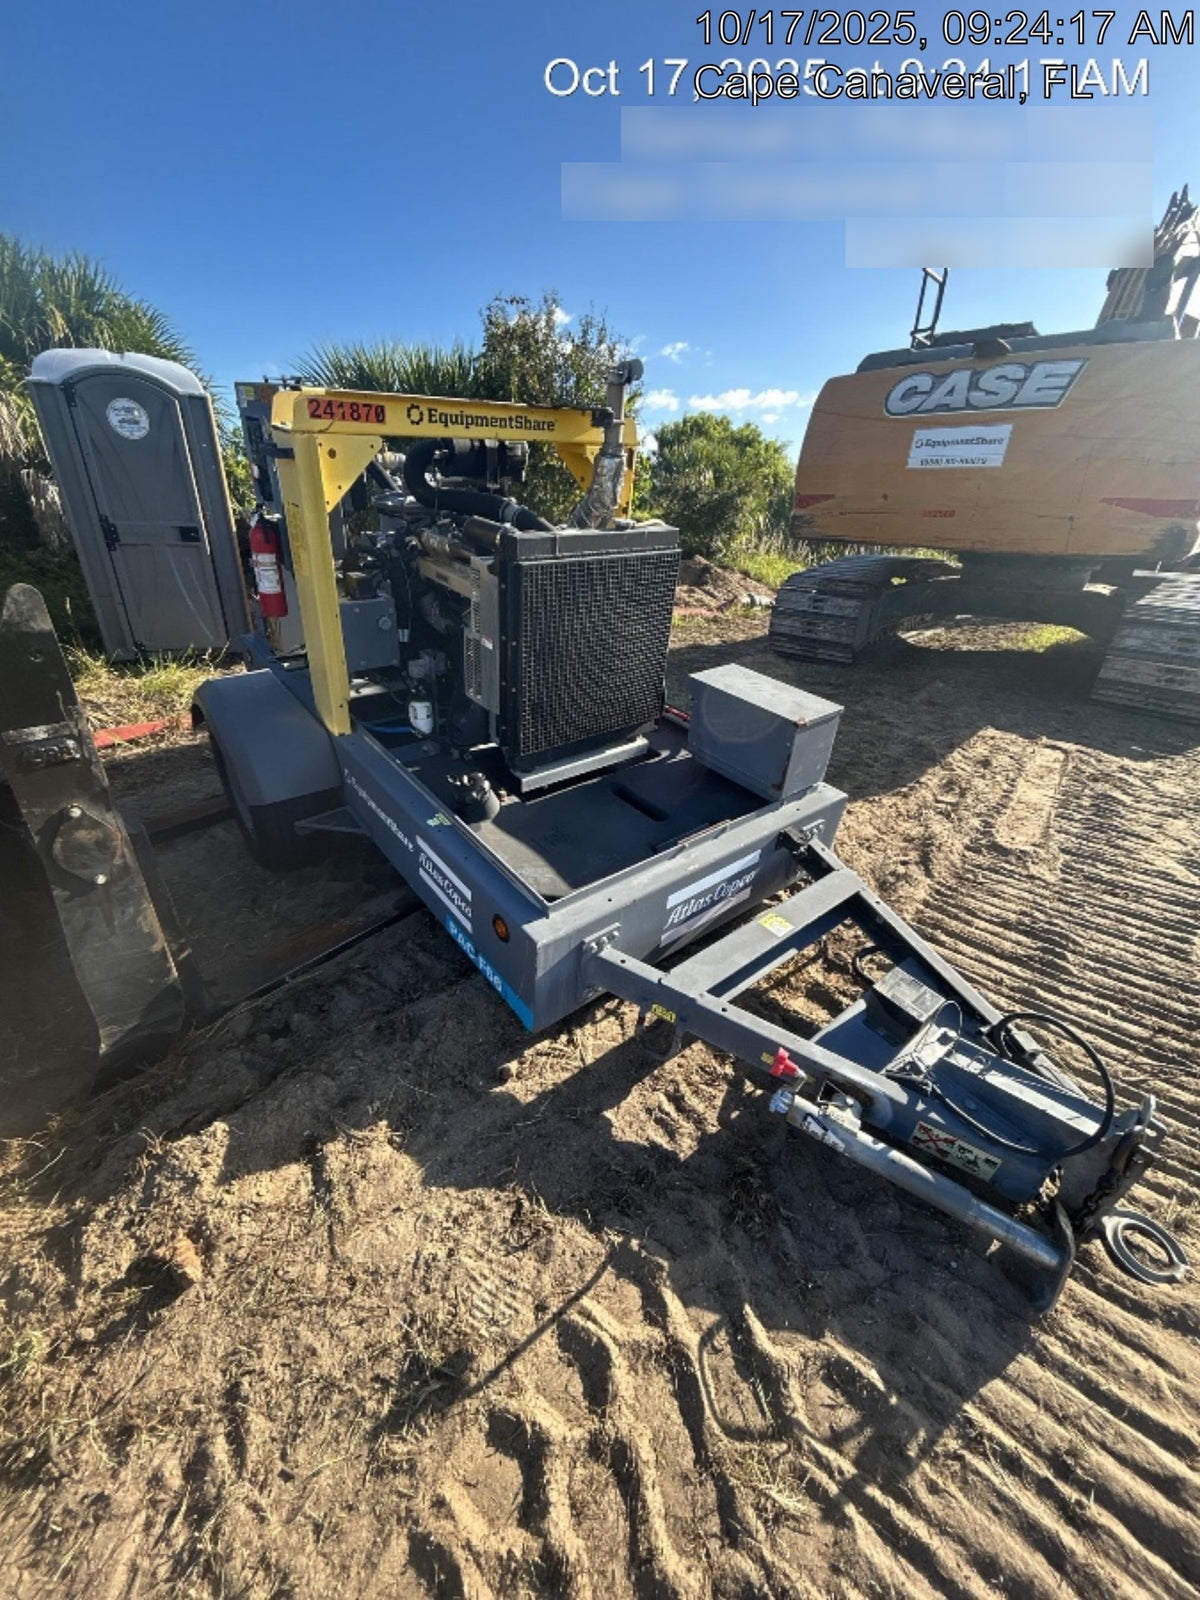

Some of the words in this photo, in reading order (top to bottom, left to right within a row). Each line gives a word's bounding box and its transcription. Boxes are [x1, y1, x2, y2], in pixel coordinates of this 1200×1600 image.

[885, 360, 1085, 415] CASE
[308, 398, 386, 423] 241870
[427, 407, 556, 431] EquipmentShare
[662, 893, 713, 931] Atlas
[713, 869, 759, 900] Copco
